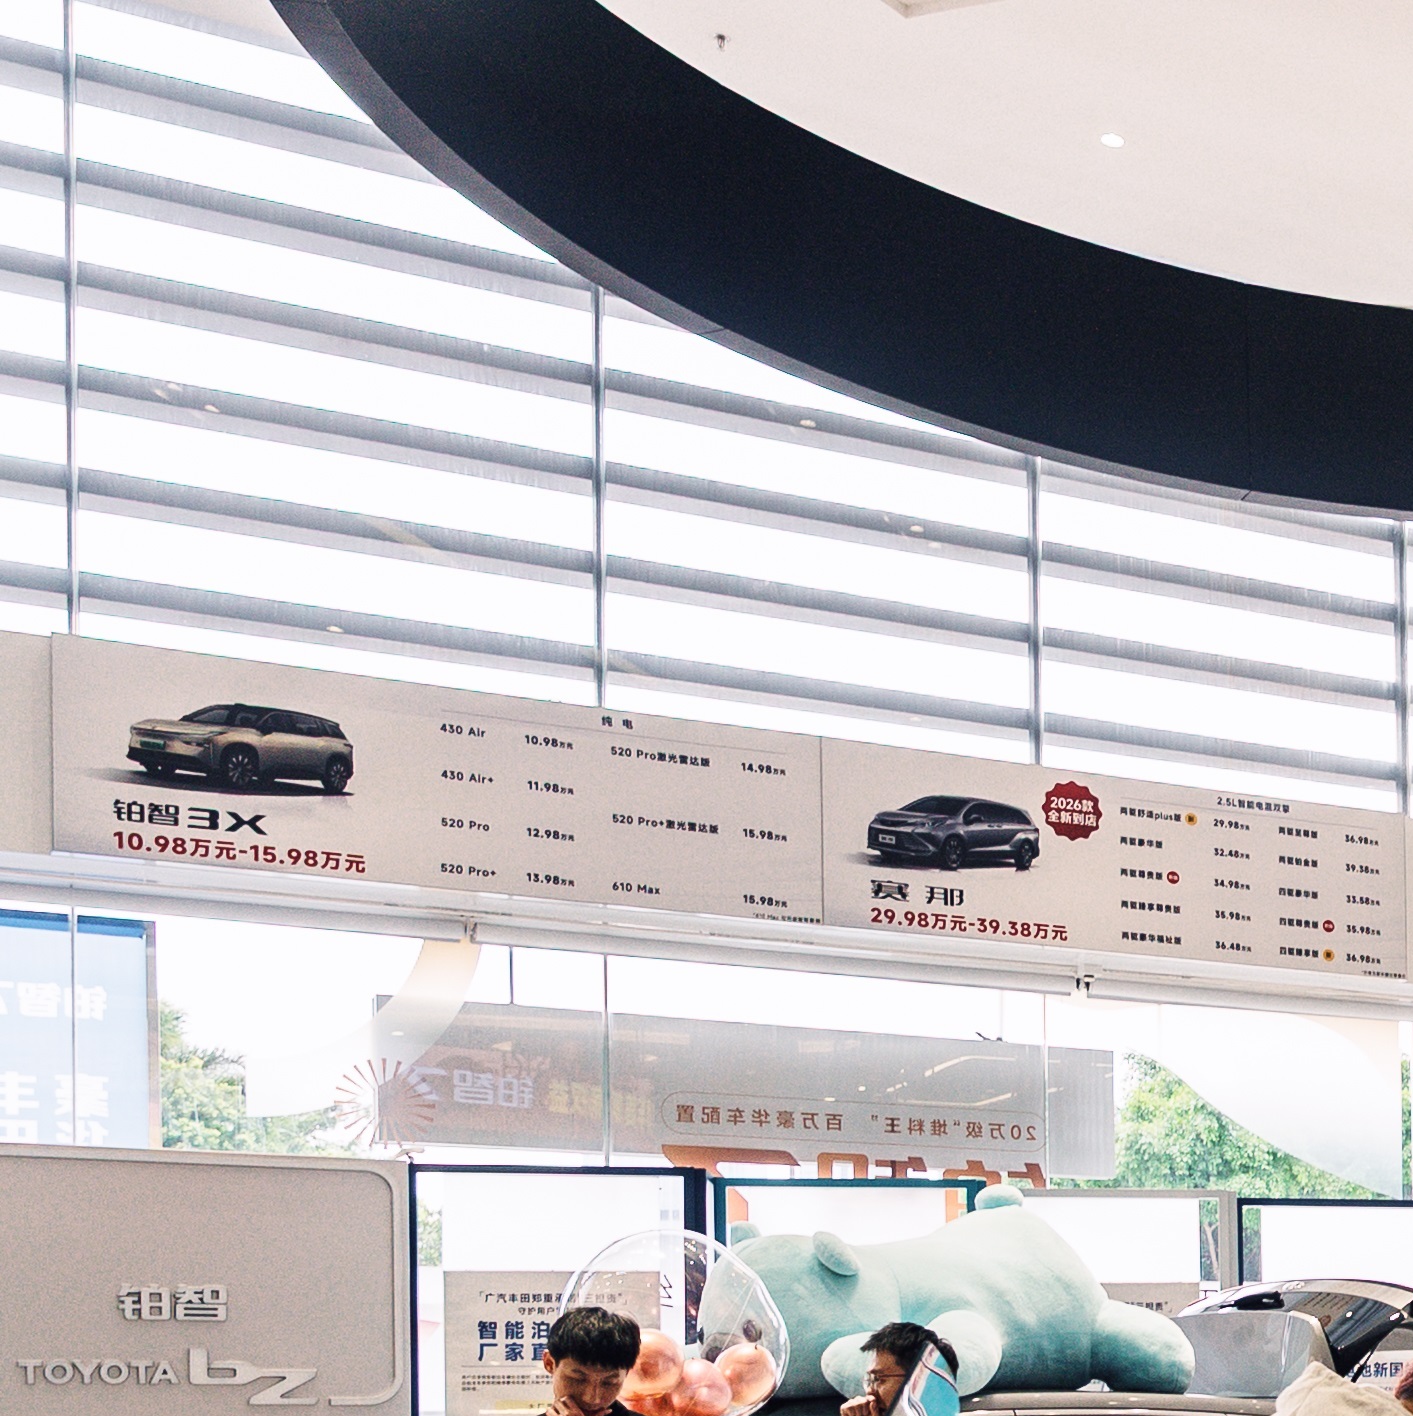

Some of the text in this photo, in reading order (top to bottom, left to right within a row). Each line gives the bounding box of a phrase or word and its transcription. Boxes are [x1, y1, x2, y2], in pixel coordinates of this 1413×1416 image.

[440, 723, 486, 738] 430 Air
[524, 734, 574, 750] 10.98万元
[611, 746, 711, 768] 520 Pro激光雷达版
[441, 769, 494, 785] 430 Air+
[741, 762, 786, 776] 14.98万元
[527, 781, 574, 796] 11.98万元
[1050, 797, 1094, 812] 2026款
[113, 799, 268, 836] 铂智3X
[441, 818, 490, 831] 520 Pro
[612, 814, 719, 834] 520 Pro+激光雷达版
[1047, 809, 1097, 827] 全新到店
[526, 827, 575, 842] 12.98万元
[742, 828, 788, 842] 15.98万元
[113, 831, 365, 874] 10.98万元-15.98万元
[441, 863, 497, 878] 520 Pro+
[526, 872, 575, 888] 13.98万元
[612, 881, 661, 895] 610 Max
[743, 894, 788, 909] 15.98万元
[870, 907, 1068, 941] 29.98万元-39.38万元
[116, 1283, 227, 1322] 铂智
[17, 1358, 181, 1385] TOYOTA
